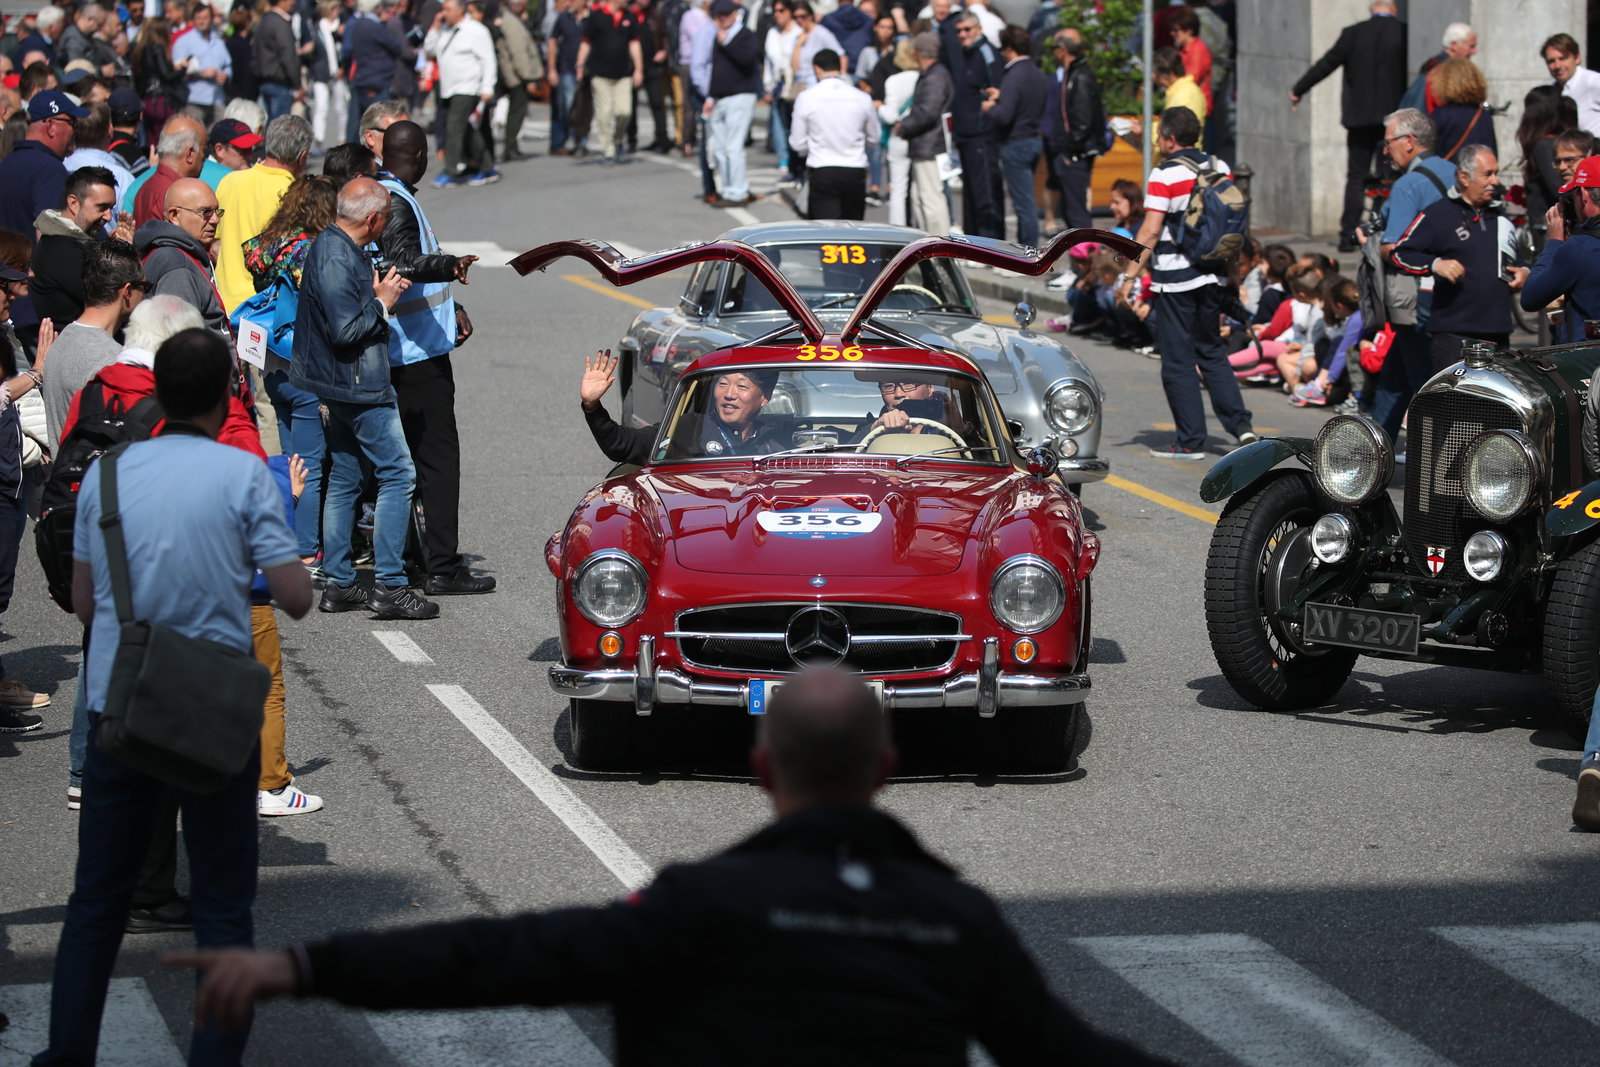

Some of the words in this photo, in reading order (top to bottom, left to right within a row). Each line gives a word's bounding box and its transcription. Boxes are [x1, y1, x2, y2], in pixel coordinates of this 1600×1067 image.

[49, 101, 59, 114] 3
[1455, 226, 1470, 241] 5
[820, 244, 867, 264] 313
[796, 345, 864, 361] 356
[777, 514, 862, 526] 356
[1308, 607, 1343, 638] XV
[1347, 613, 1414, 647] 3207
[753, 700, 760, 708] D
